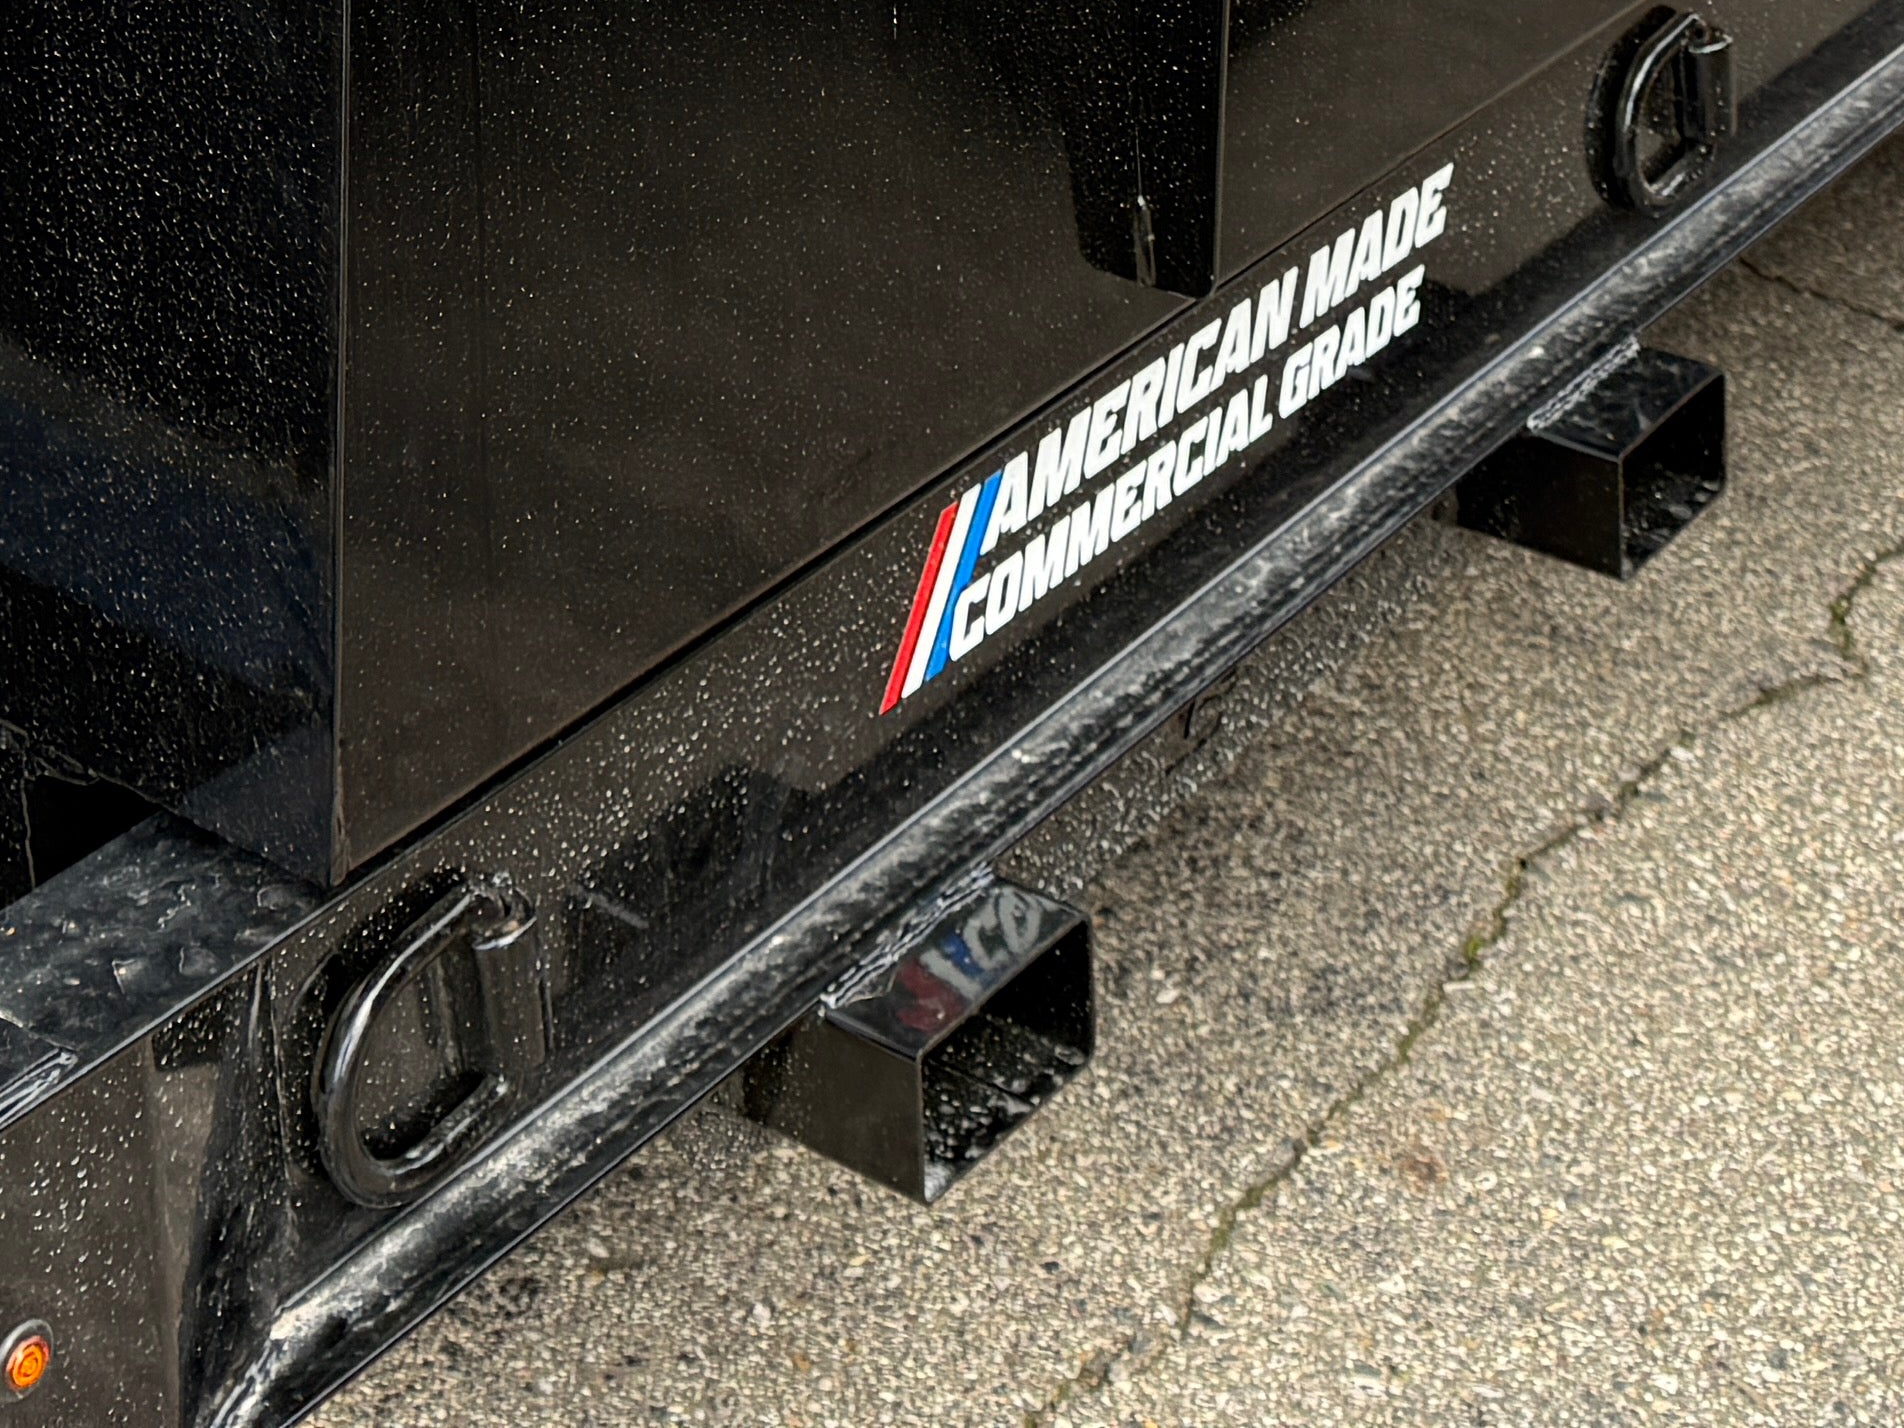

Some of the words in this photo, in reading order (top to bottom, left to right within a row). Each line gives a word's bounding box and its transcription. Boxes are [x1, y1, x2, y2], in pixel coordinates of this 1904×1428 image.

[949, 374, 1273, 662] COMMERCIAL
[1280, 264, 1426, 419] GRADE
[980, 266, 1299, 556] AMERICAN
[1299, 162, 1454, 328] MADE
